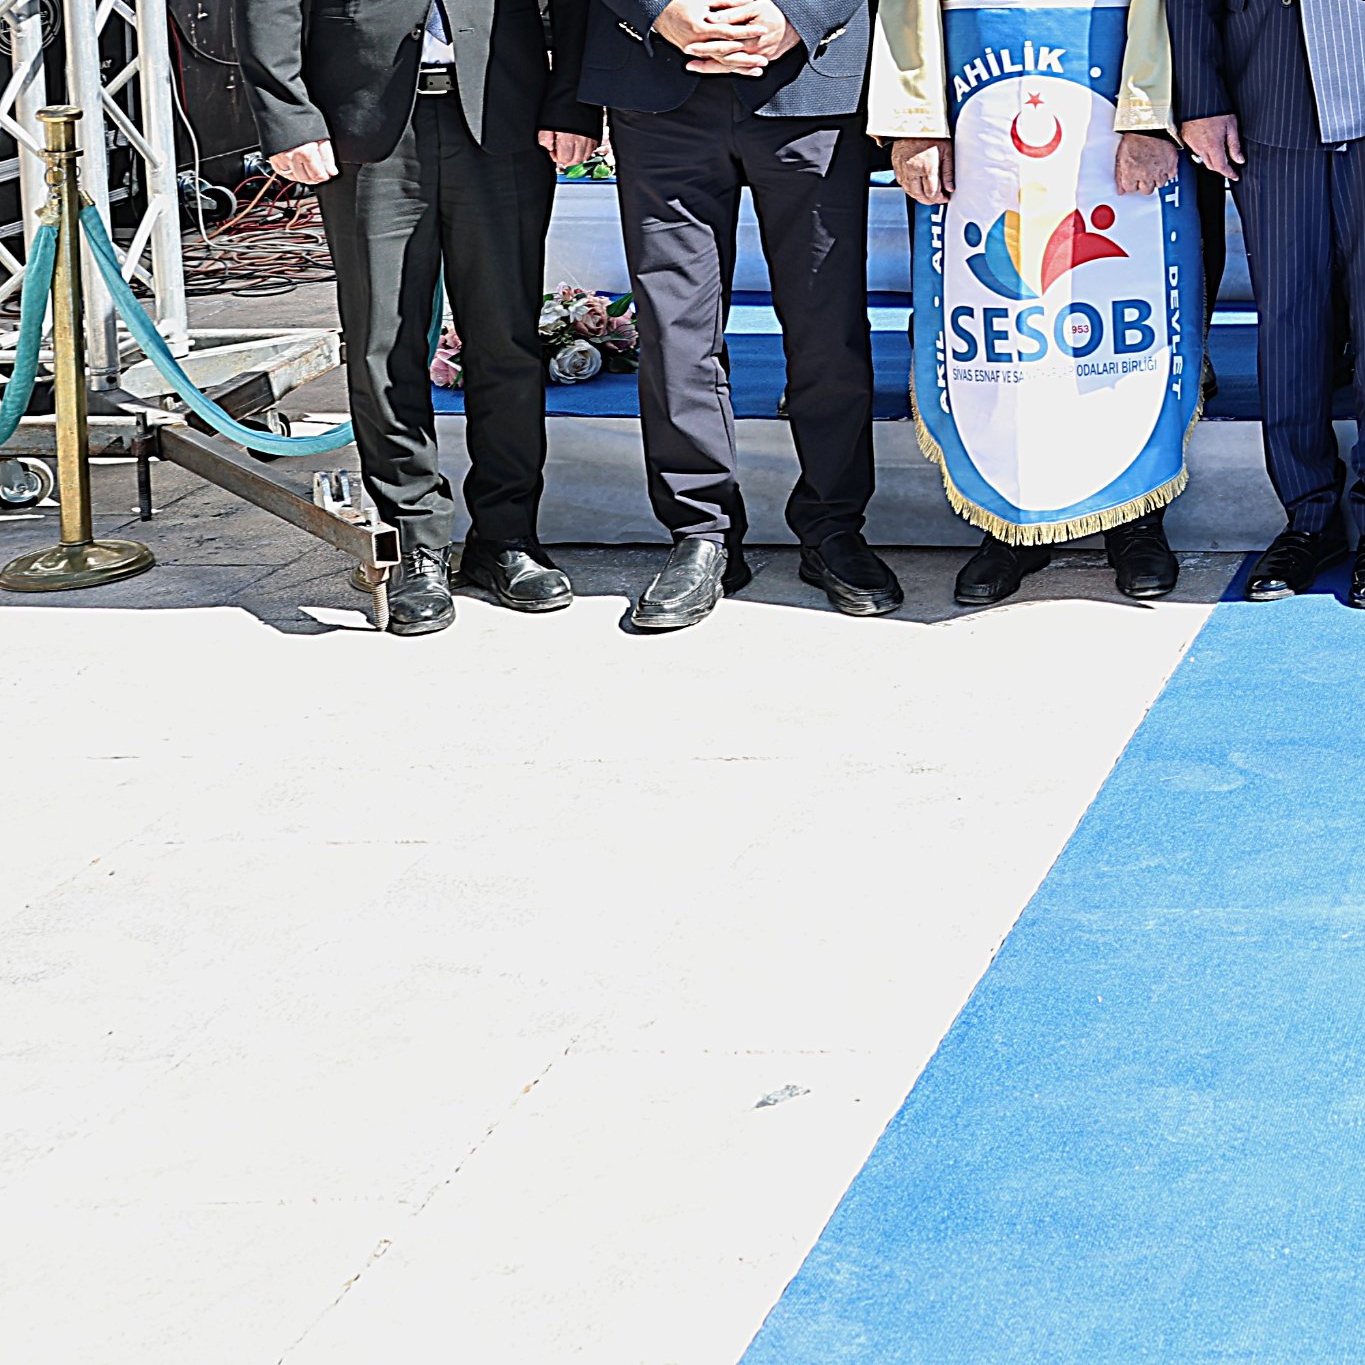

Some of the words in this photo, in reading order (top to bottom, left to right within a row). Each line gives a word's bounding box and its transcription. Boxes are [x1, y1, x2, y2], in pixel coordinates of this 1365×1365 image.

[952, 40, 1067, 103] AHİLİK
[950, 299, 1156, 363] SESOB
[1071, 324, 1090, 334] 953
[1168, 265, 1182, 401] DEVLET
[952, 365, 973, 382] SİVAS
[974, 369, 1000, 383] ESNAF
[1001, 370, 1013, 383] VE
[1076, 361, 1119, 377] ODALARI
[1121, 356, 1158, 374] BİRLİĞİ
